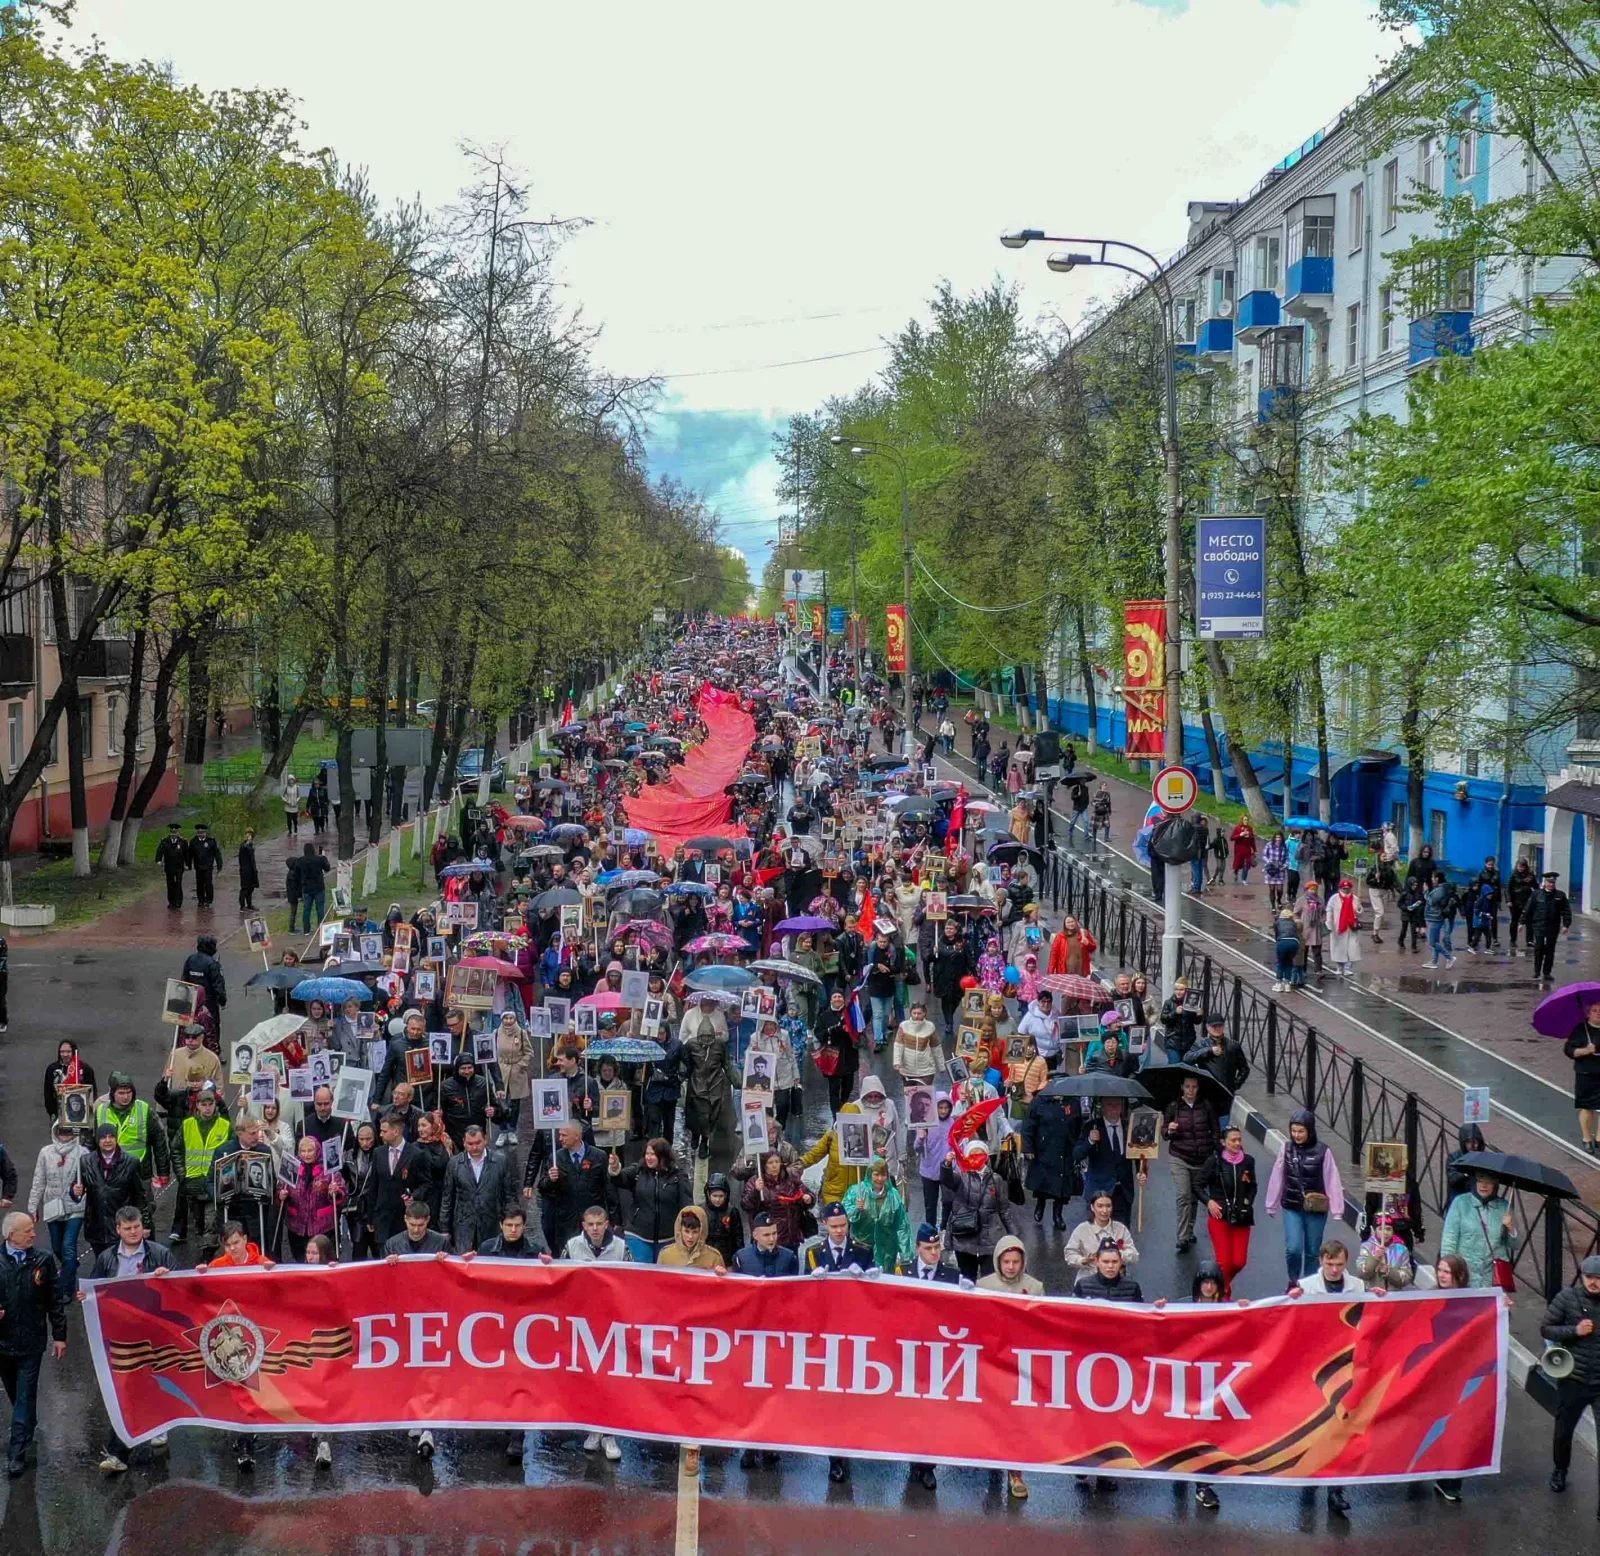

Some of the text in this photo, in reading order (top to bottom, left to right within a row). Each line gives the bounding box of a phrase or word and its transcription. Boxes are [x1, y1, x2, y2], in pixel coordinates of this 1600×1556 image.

[1208, 534, 1254, 547] МЕСТО
[1203, 549, 1259, 563] свободно
[1207, 591, 1224, 600] (925)
[888, 624, 898, 638] 9
[1127, 648, 1148, 678] 9
[1127, 718, 1162, 733] МАЯ
[352, 1311, 1253, 1421] БЕССМЕРТНЫЙ ПОЛК
